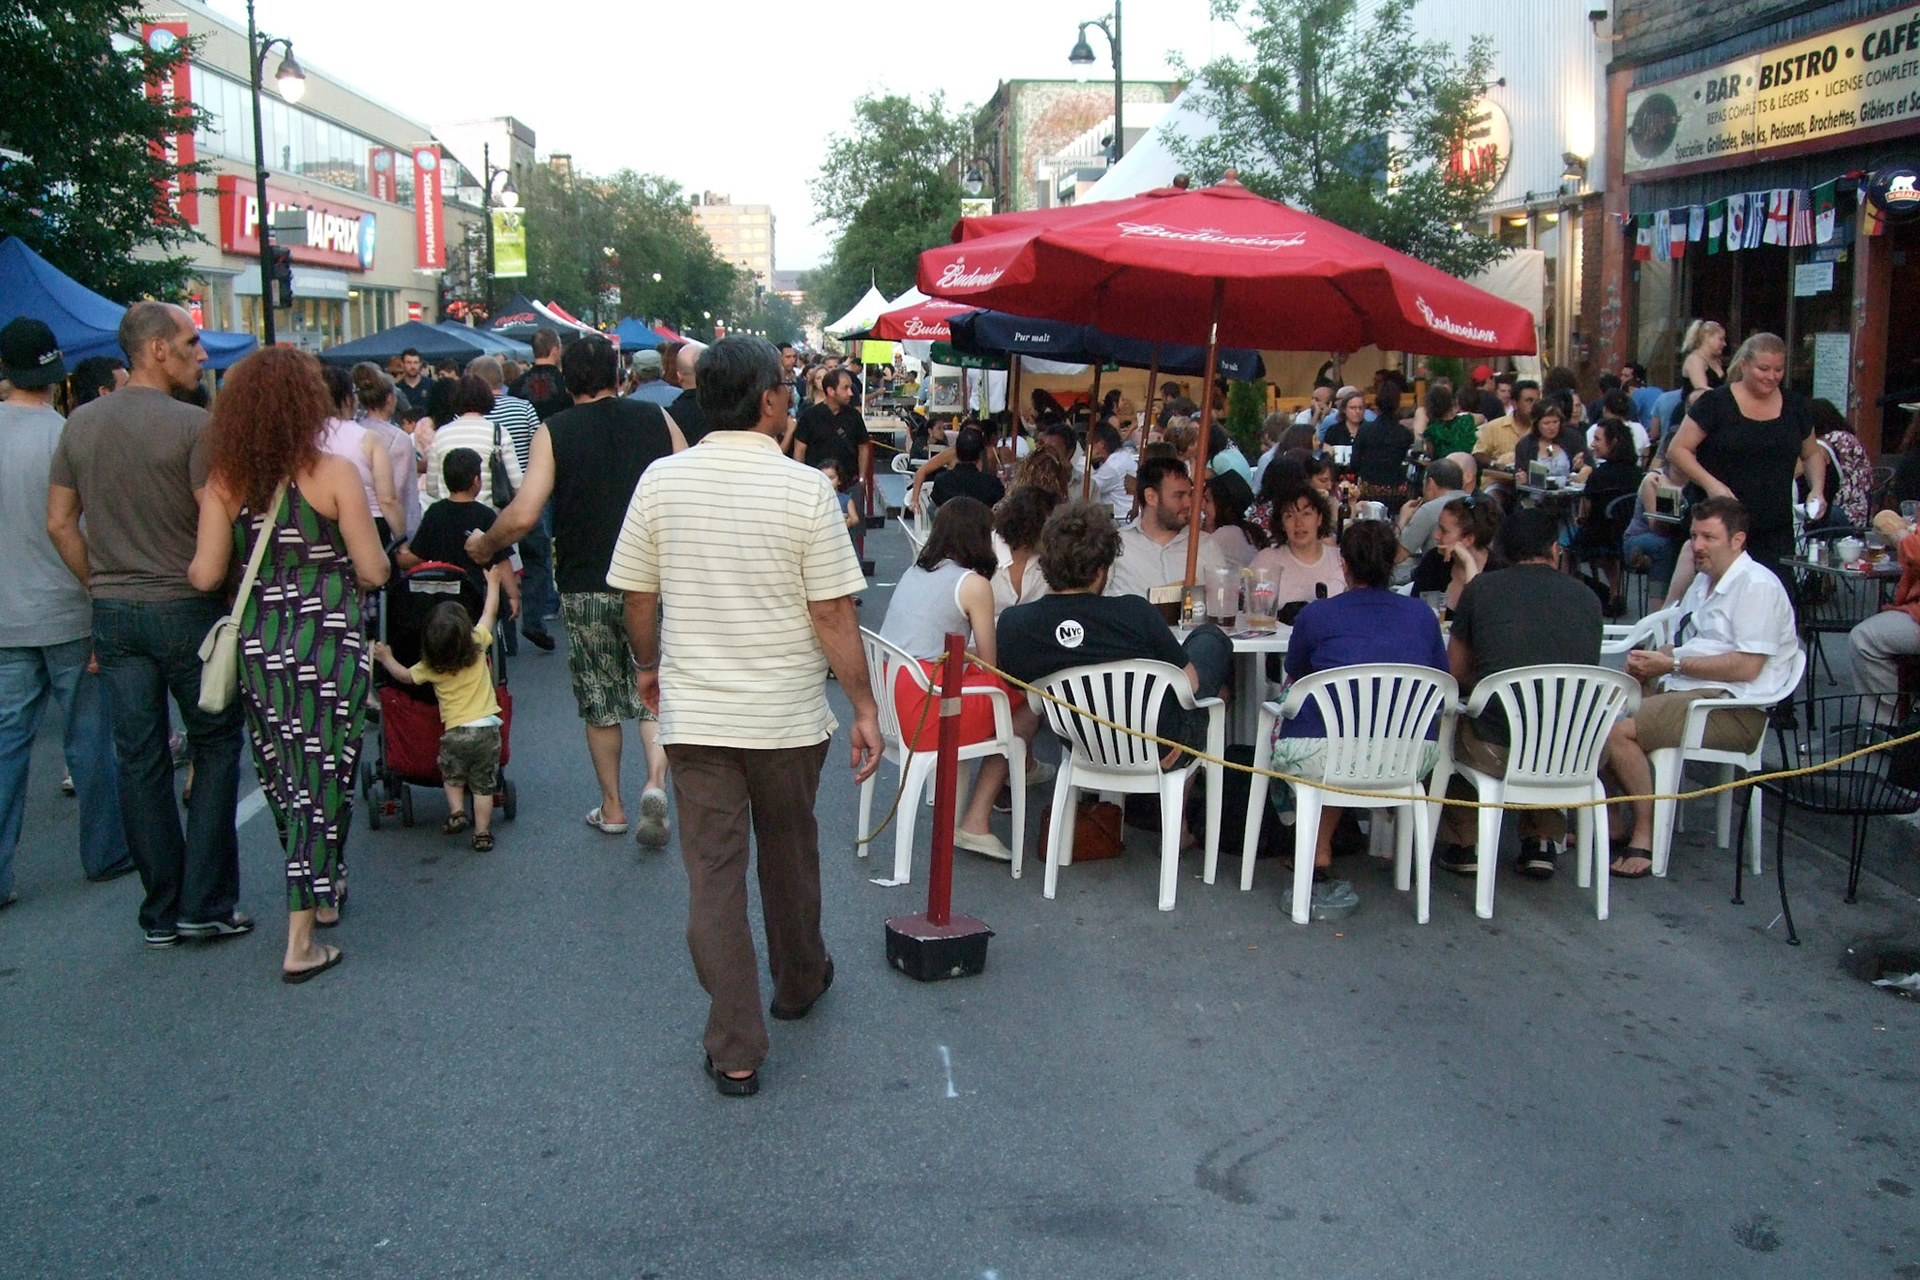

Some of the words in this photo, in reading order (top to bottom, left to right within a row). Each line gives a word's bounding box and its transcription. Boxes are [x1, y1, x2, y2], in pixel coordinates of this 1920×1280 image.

[1706, 74, 1741, 105] BAR
[1759, 45, 1838, 91] BISTRO
[1862, 12, 1920, 62] CAFÉ
[1707, 108, 1727, 125] REPAS
[1769, 98, 1776, 111] &
[1778, 89, 1809, 109] LÉGERS
[1825, 74, 1863, 98] LICENSE
[1770, 120, 1806, 141] Poissons,
[1809, 108, 1858, 134] Brochettes,
[1860, 98, 1894, 122] Gibiers
[1897, 95, 1908, 114] et
[244, 194, 359, 254] PAPRIX
[423, 172, 436, 264] PHARMAPRIX
[1117, 222, 1306, 247] Budweiser
[1014, 331, 1030, 341] Pur
[1031, 333, 1050, 342] malt
[1416, 299, 1497, 342] Budweiser
[1060, 626, 1082, 640] NYC
